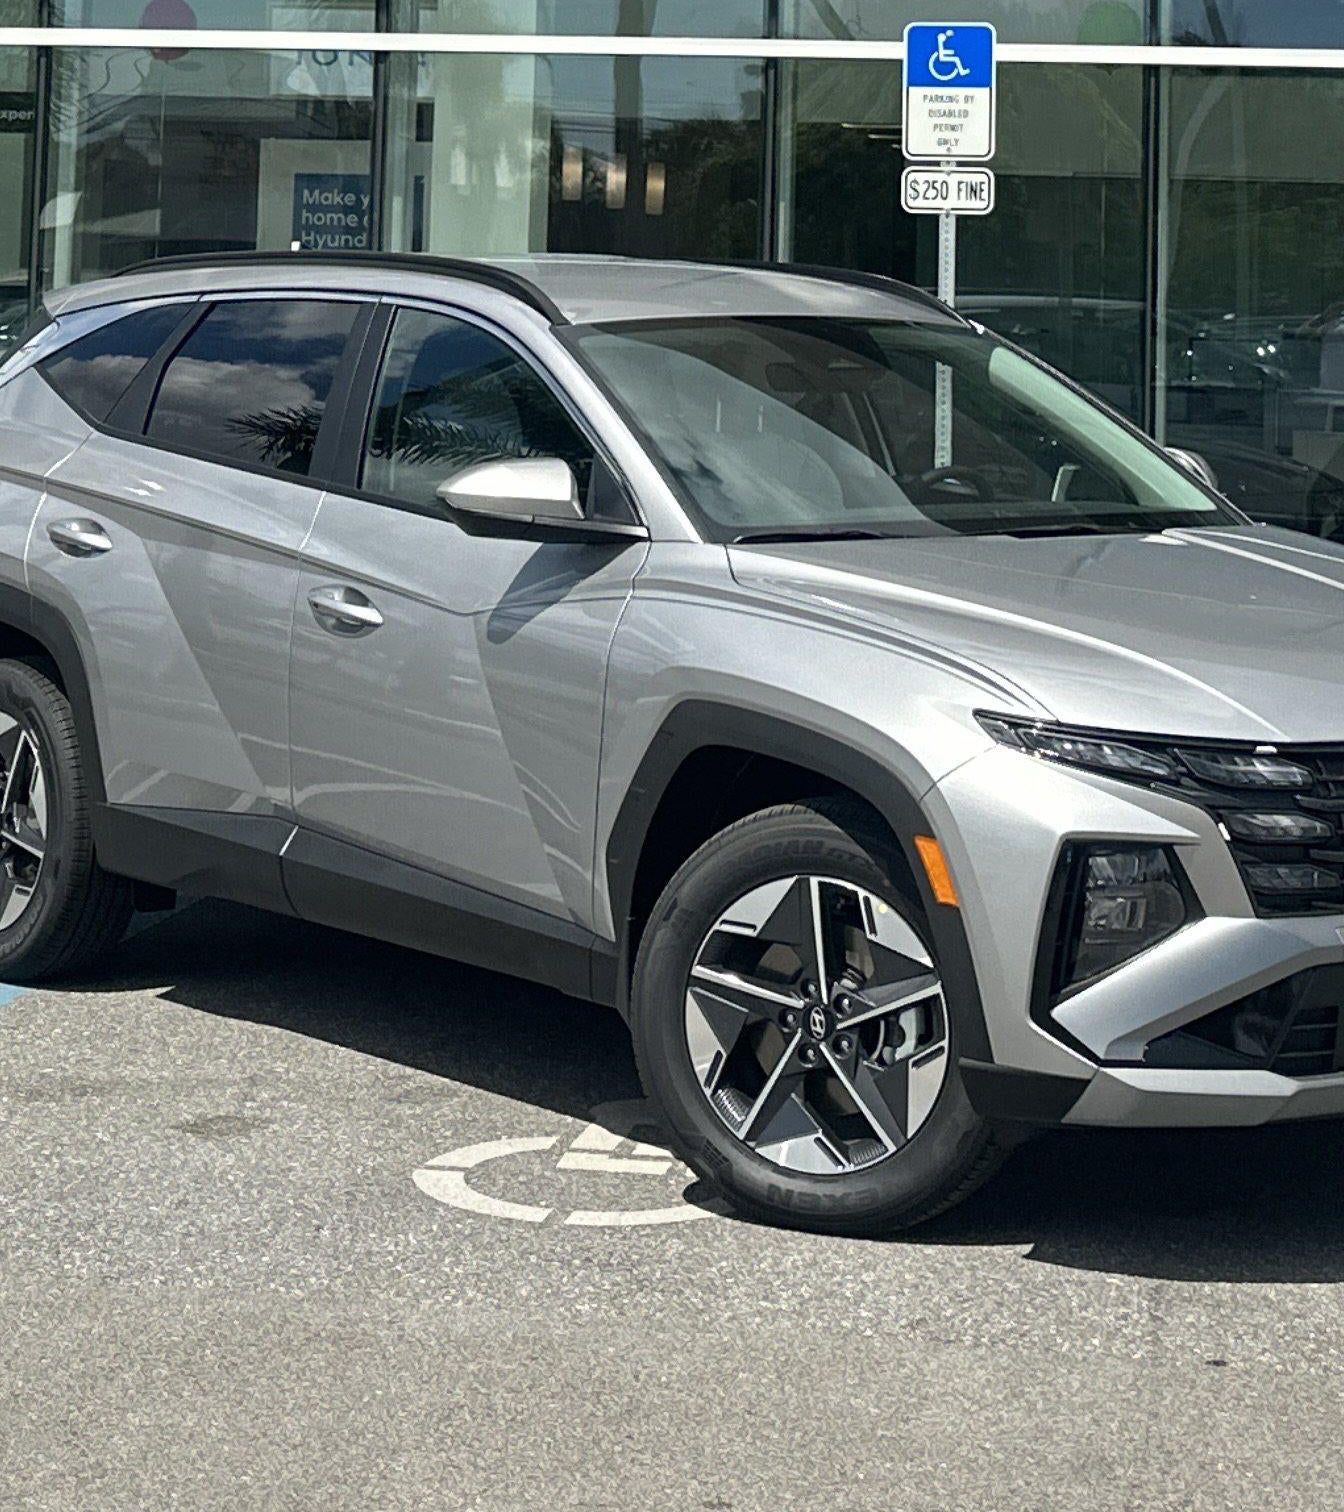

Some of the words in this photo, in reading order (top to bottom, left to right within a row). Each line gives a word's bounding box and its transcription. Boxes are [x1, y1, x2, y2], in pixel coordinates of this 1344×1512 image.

[922, 94, 960, 104] PARKING
[928, 108, 969, 119] DISABLED
[933, 123, 964, 133] PERMIT
[936, 137, 960, 147] ONLY
[908, 178, 950, 202] $250
[956, 180, 986, 202] FINE
[302, 188, 356, 206] Make
[301, 208, 357, 227] home
